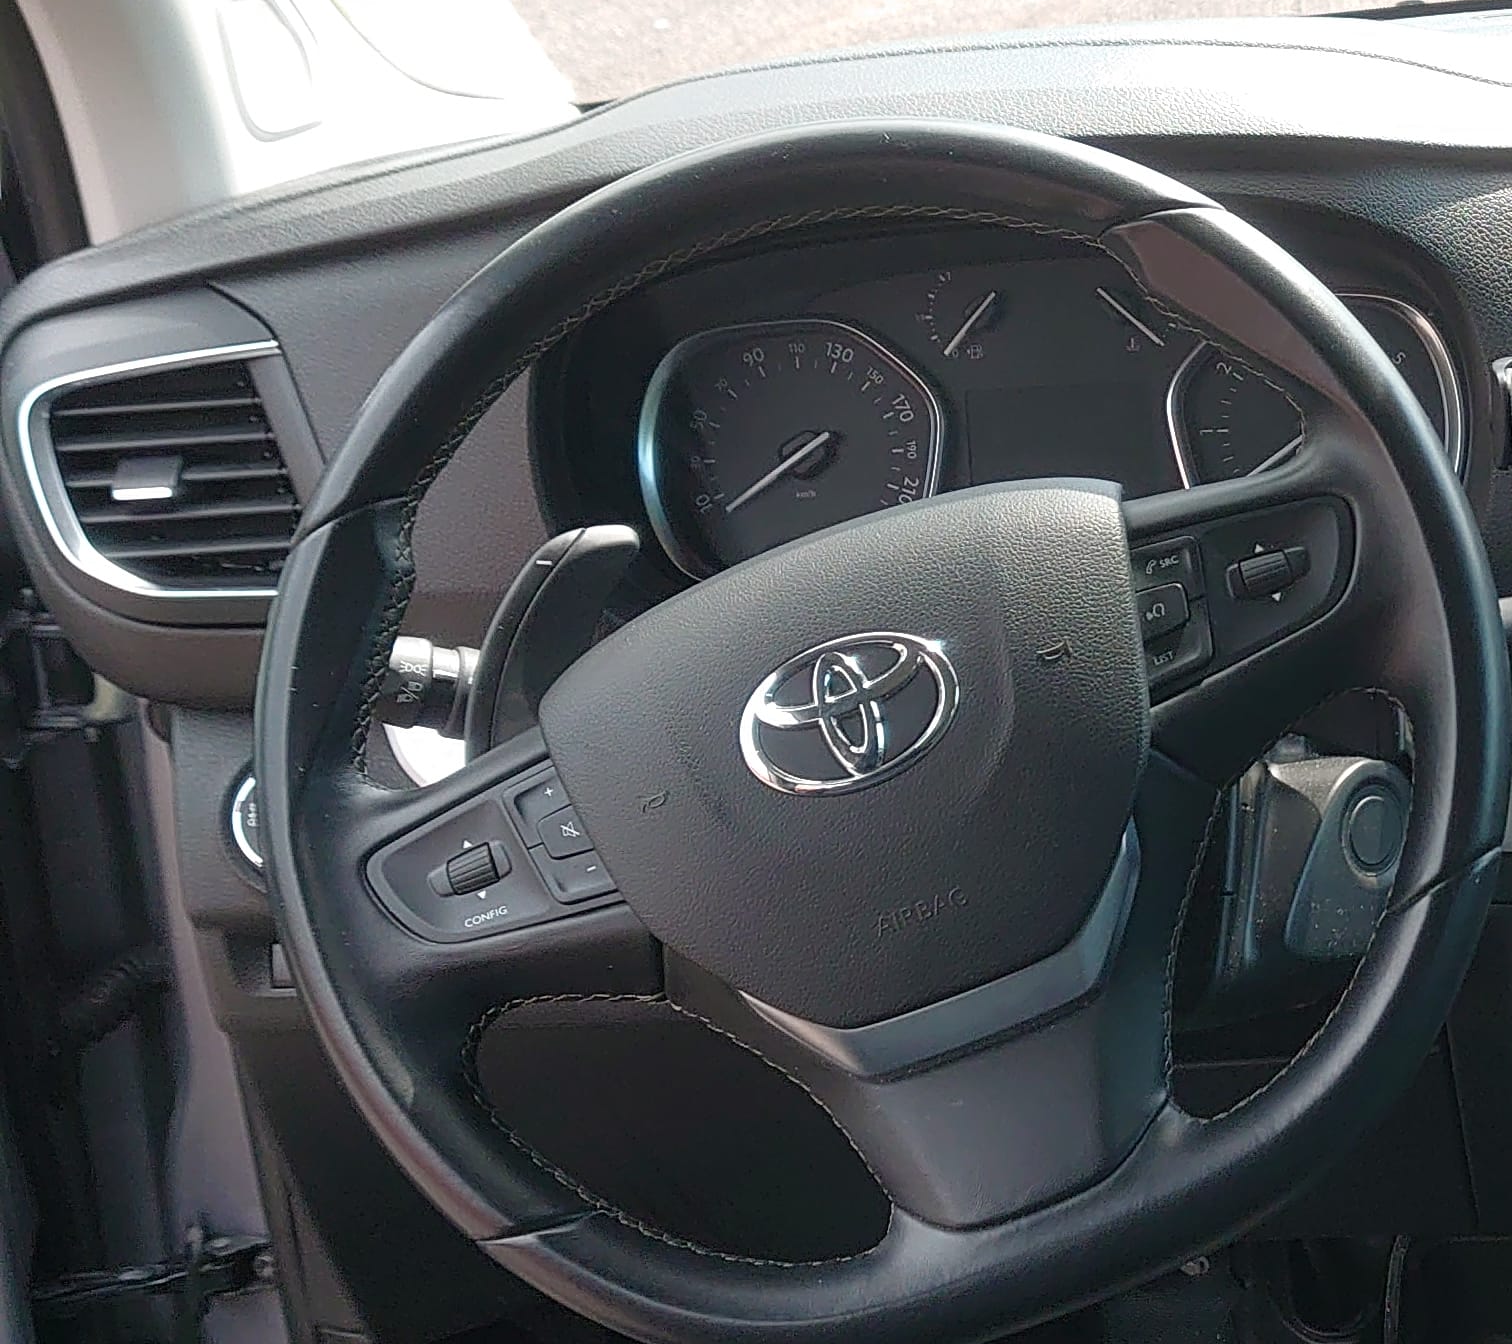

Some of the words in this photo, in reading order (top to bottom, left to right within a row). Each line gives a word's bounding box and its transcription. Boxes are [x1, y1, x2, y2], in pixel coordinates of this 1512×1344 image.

[742, 347, 765, 367] 90
[788, 343, 805, 354] 110
[825, 342, 854, 363] 130
[1392, 351, 1407, 365] 5
[867, 367, 884, 385] 150
[1216, 362, 1232, 375] 2
[892, 393, 914, 423] 170
[906, 440, 917, 459] 190
[898, 477, 919, 504] 210
[696, 494, 712, 513] 10
[1158, 555, 1180, 569] SRC
[1152, 650, 1175, 666] LIST
[464, 905, 508, 928] CONFIG
[871, 886, 969, 937] AIRBAG
